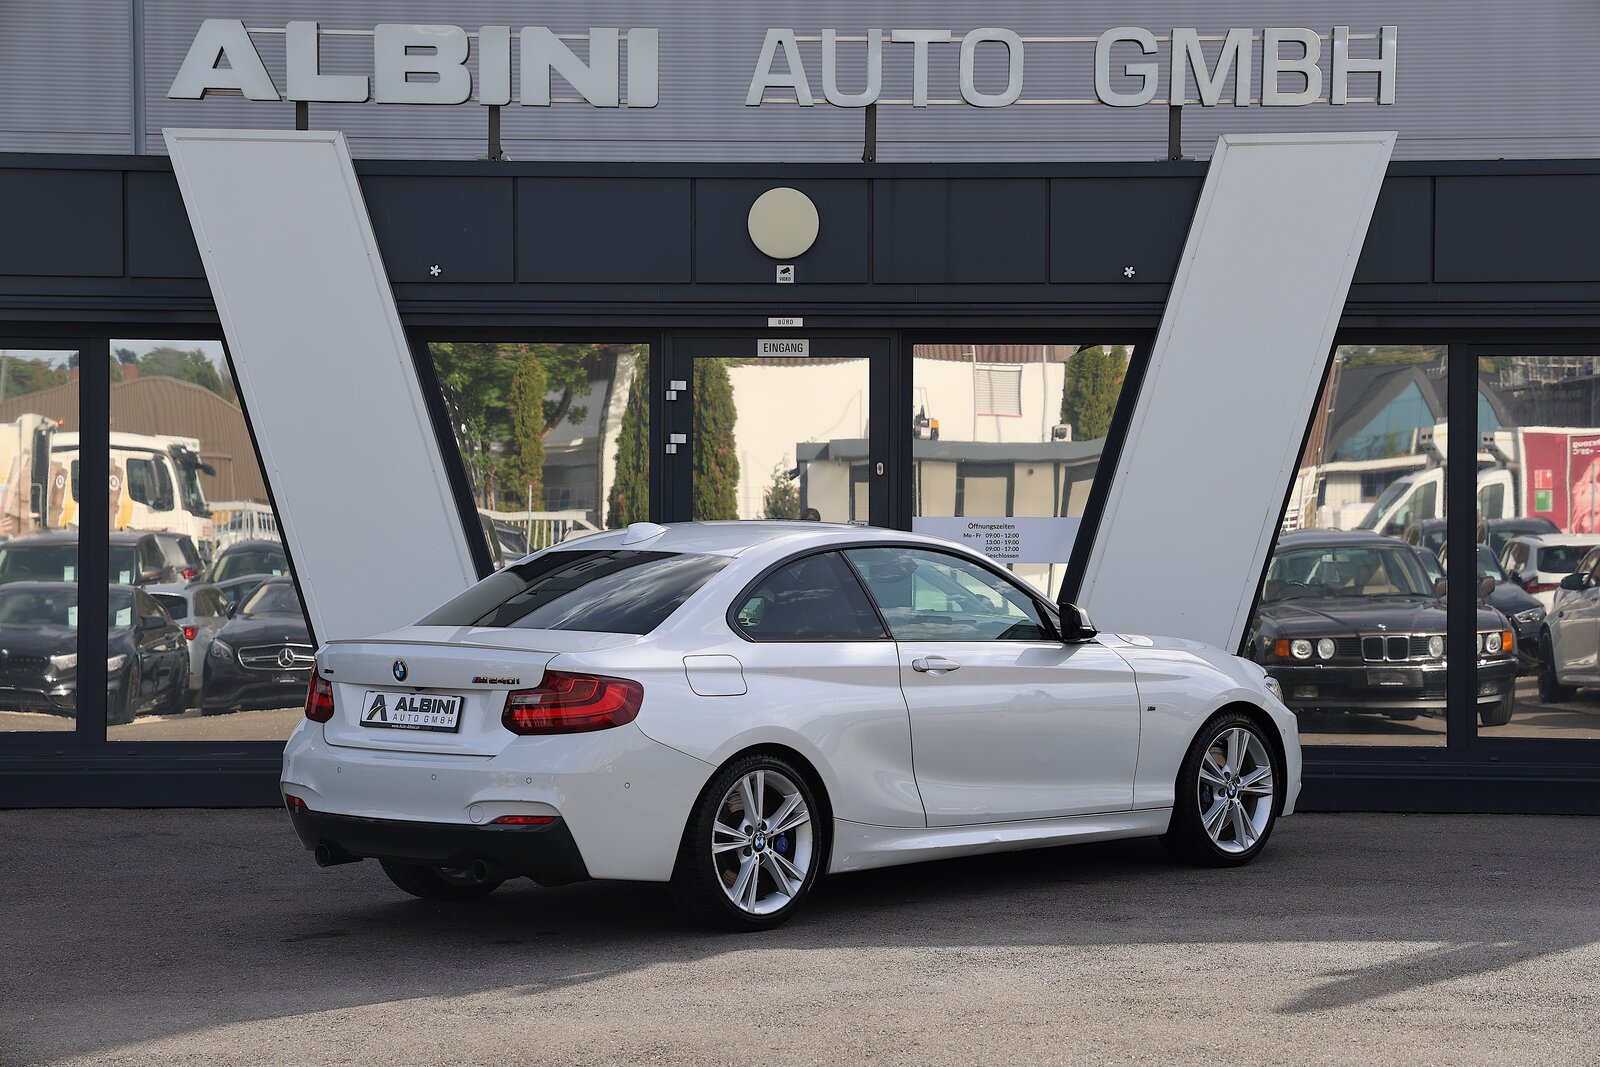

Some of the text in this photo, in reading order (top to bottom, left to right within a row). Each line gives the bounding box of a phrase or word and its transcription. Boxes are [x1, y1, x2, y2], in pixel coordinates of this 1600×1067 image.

[168, 19, 1398, 108] ALBINI AUTO GMBH
[764, 342, 804, 353] EINGANG
[395, 697, 456, 714] ALBINI
[392, 714, 454, 724] AUTO GMBH
